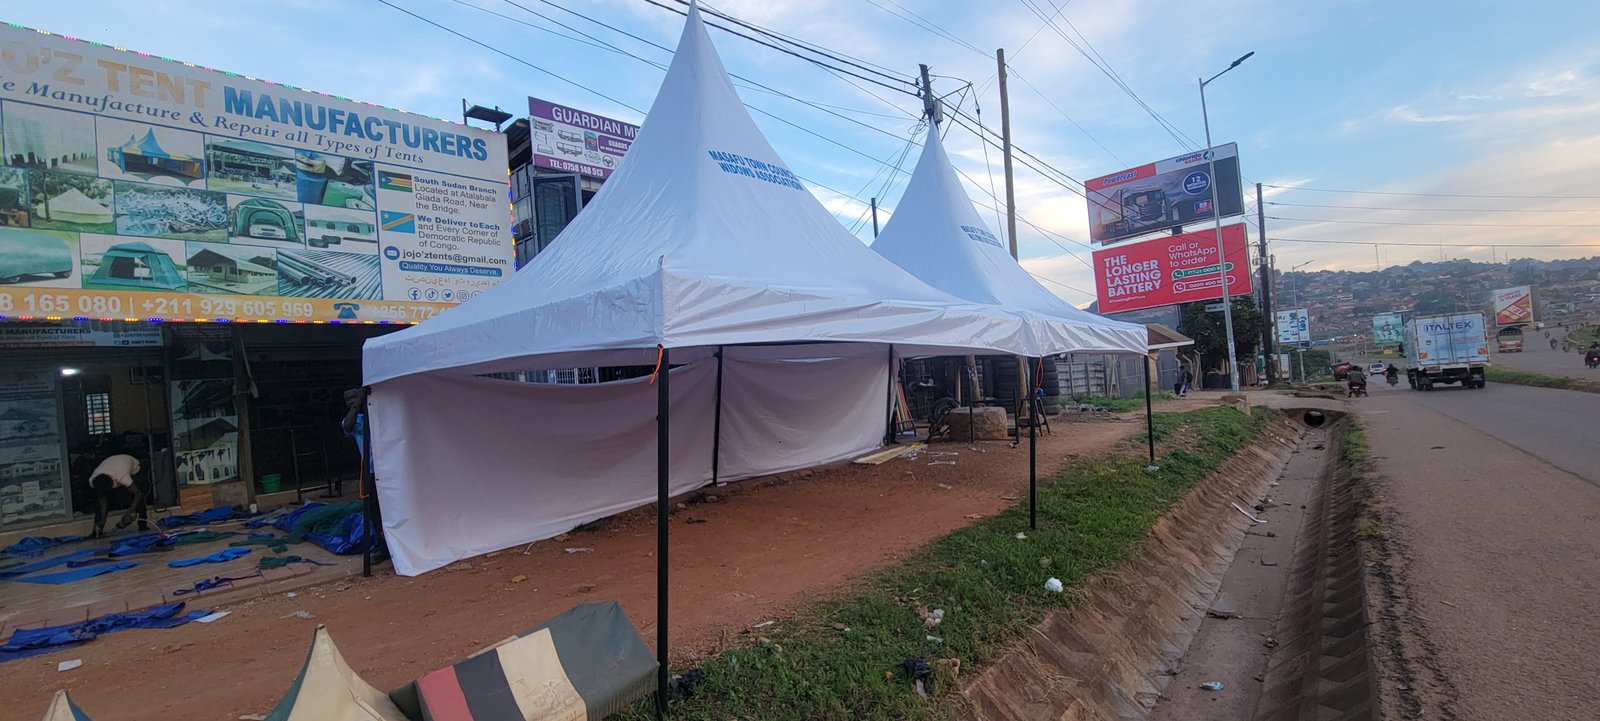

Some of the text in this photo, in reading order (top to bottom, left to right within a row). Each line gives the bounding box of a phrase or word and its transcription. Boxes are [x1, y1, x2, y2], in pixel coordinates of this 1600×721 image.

[97, 58, 213, 109] TENT
[223, 86, 488, 162] MANUFACTURERS
[24, 81, 182, 121] Manufacture
[189, 112, 209, 129] &
[214, 116, 279, 138] Repair
[285, 130, 309, 143] all
[315, 133, 360, 154] Types
[365, 144, 382, 159] of
[385, 147, 424, 164] Tents
[552, 106, 620, 135] GUARDIAN
[708, 150, 746, 166] MASAFU
[744, 157, 769, 173] TOWN
[718, 162, 755, 178] WIDOWS
[414, 175, 497, 195] South Sudan Branch
[1191, 175, 1201, 183] 12
[415, 183, 448, 196] Located
[450, 189, 458, 197] at
[415, 201, 461, 215] the Bridge.
[469, 200, 488, 210] Near
[417, 214, 433, 223] We
[435, 216, 467, 227] Deliver
[418, 222, 498, 238] and Every Corner of
[418, 231, 501, 247] Democratic Republic
[419, 239, 428, 248] of
[1168, 242, 1199, 253] Call or
[1168, 246, 1217, 260] WhatsApp
[402, 262, 428, 271] Quality
[429, 264, 442, 272] You
[444, 265, 468, 274] Always
[1104, 255, 1127, 269] THE
[1105, 260, 1159, 278] LONGER
[1170, 255, 1207, 268] to order
[1106, 269, 1162, 288] LASTING
[1107, 280, 1163, 298] BATTERY
[23, 294, 70, 313] 165
[78, 295, 121, 313] 080
[142, 297, 192, 314] +211
[201, 299, 237, 315] 929
[243, 301, 276, 316] 605
[281, 302, 313, 317] 969
[1425, 320, 1472, 332] ITALTEX
